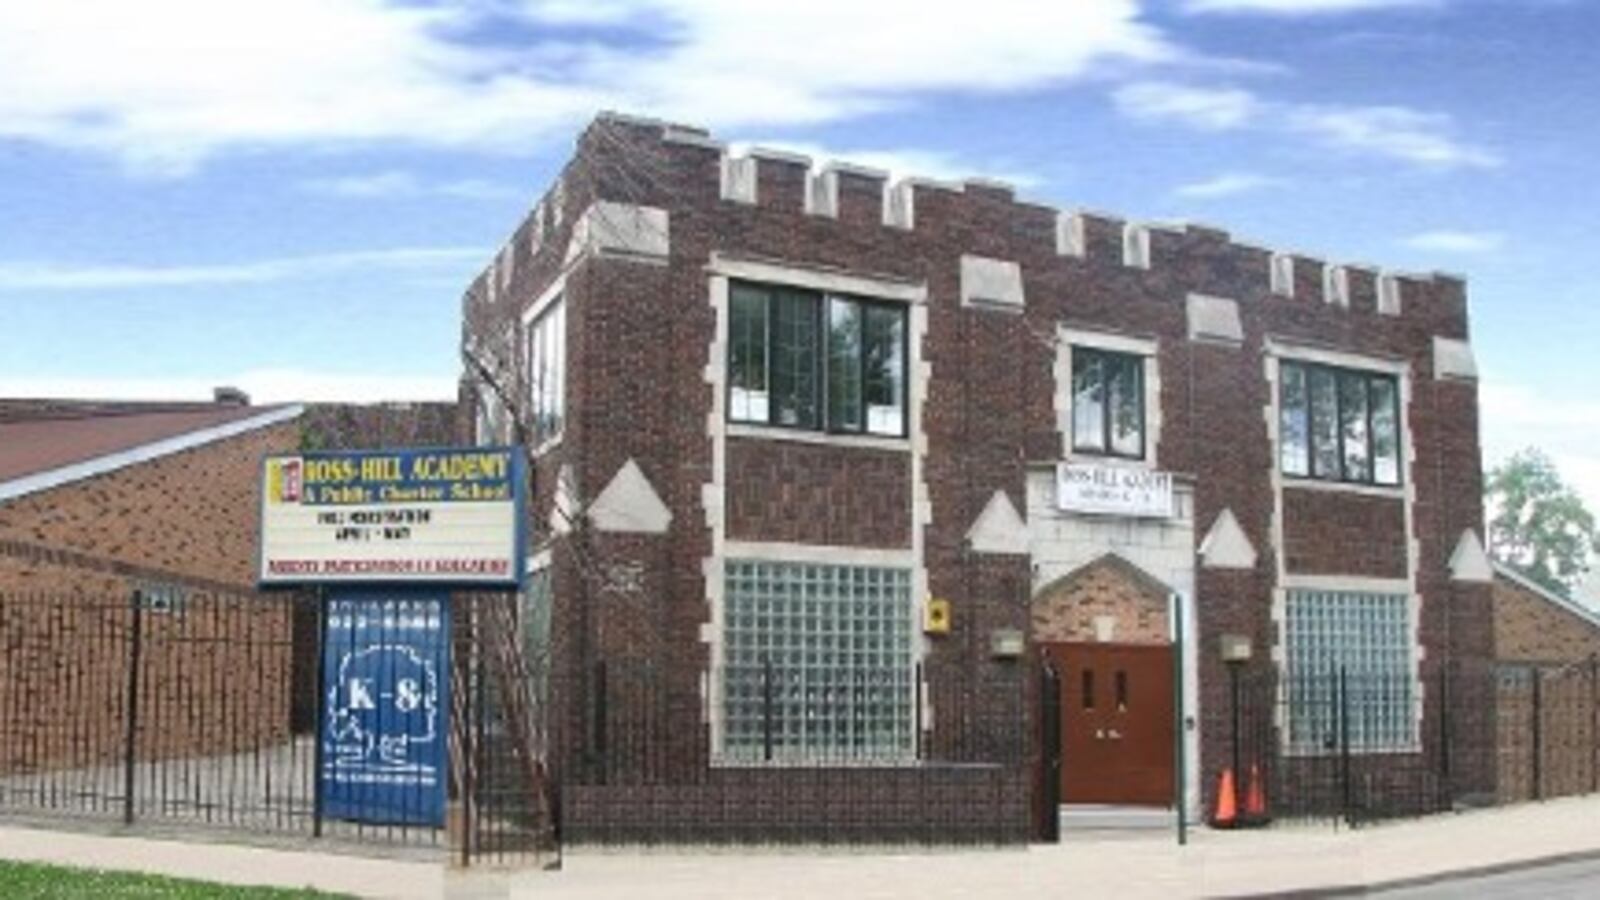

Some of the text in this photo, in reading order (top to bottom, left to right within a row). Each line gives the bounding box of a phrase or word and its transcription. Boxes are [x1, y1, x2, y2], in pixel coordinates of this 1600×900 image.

[411, 453, 507, 480] ACADEMY
[379, 484, 444, 502] Charter
[450, 481, 508, 499] School
